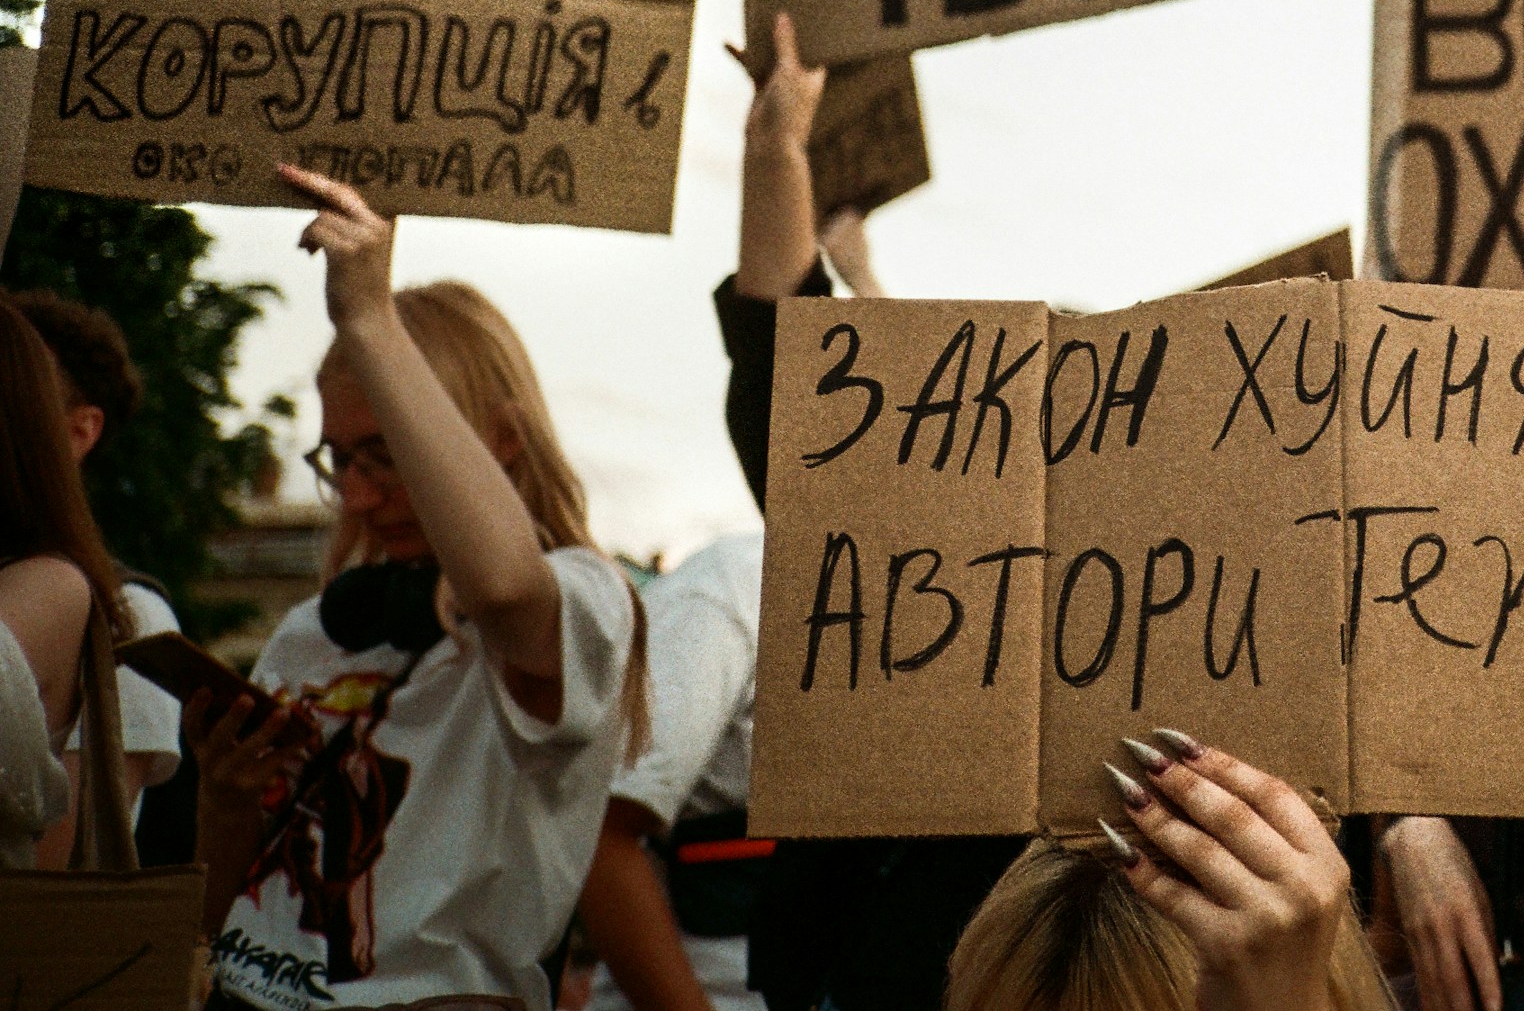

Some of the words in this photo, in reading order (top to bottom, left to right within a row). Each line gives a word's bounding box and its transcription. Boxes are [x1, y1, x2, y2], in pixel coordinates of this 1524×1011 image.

[133, 141, 243, 187] ОКО
[800, 317, 1169, 481] ЗАКОН
[800, 531, 1263, 712] АВТОРИ
